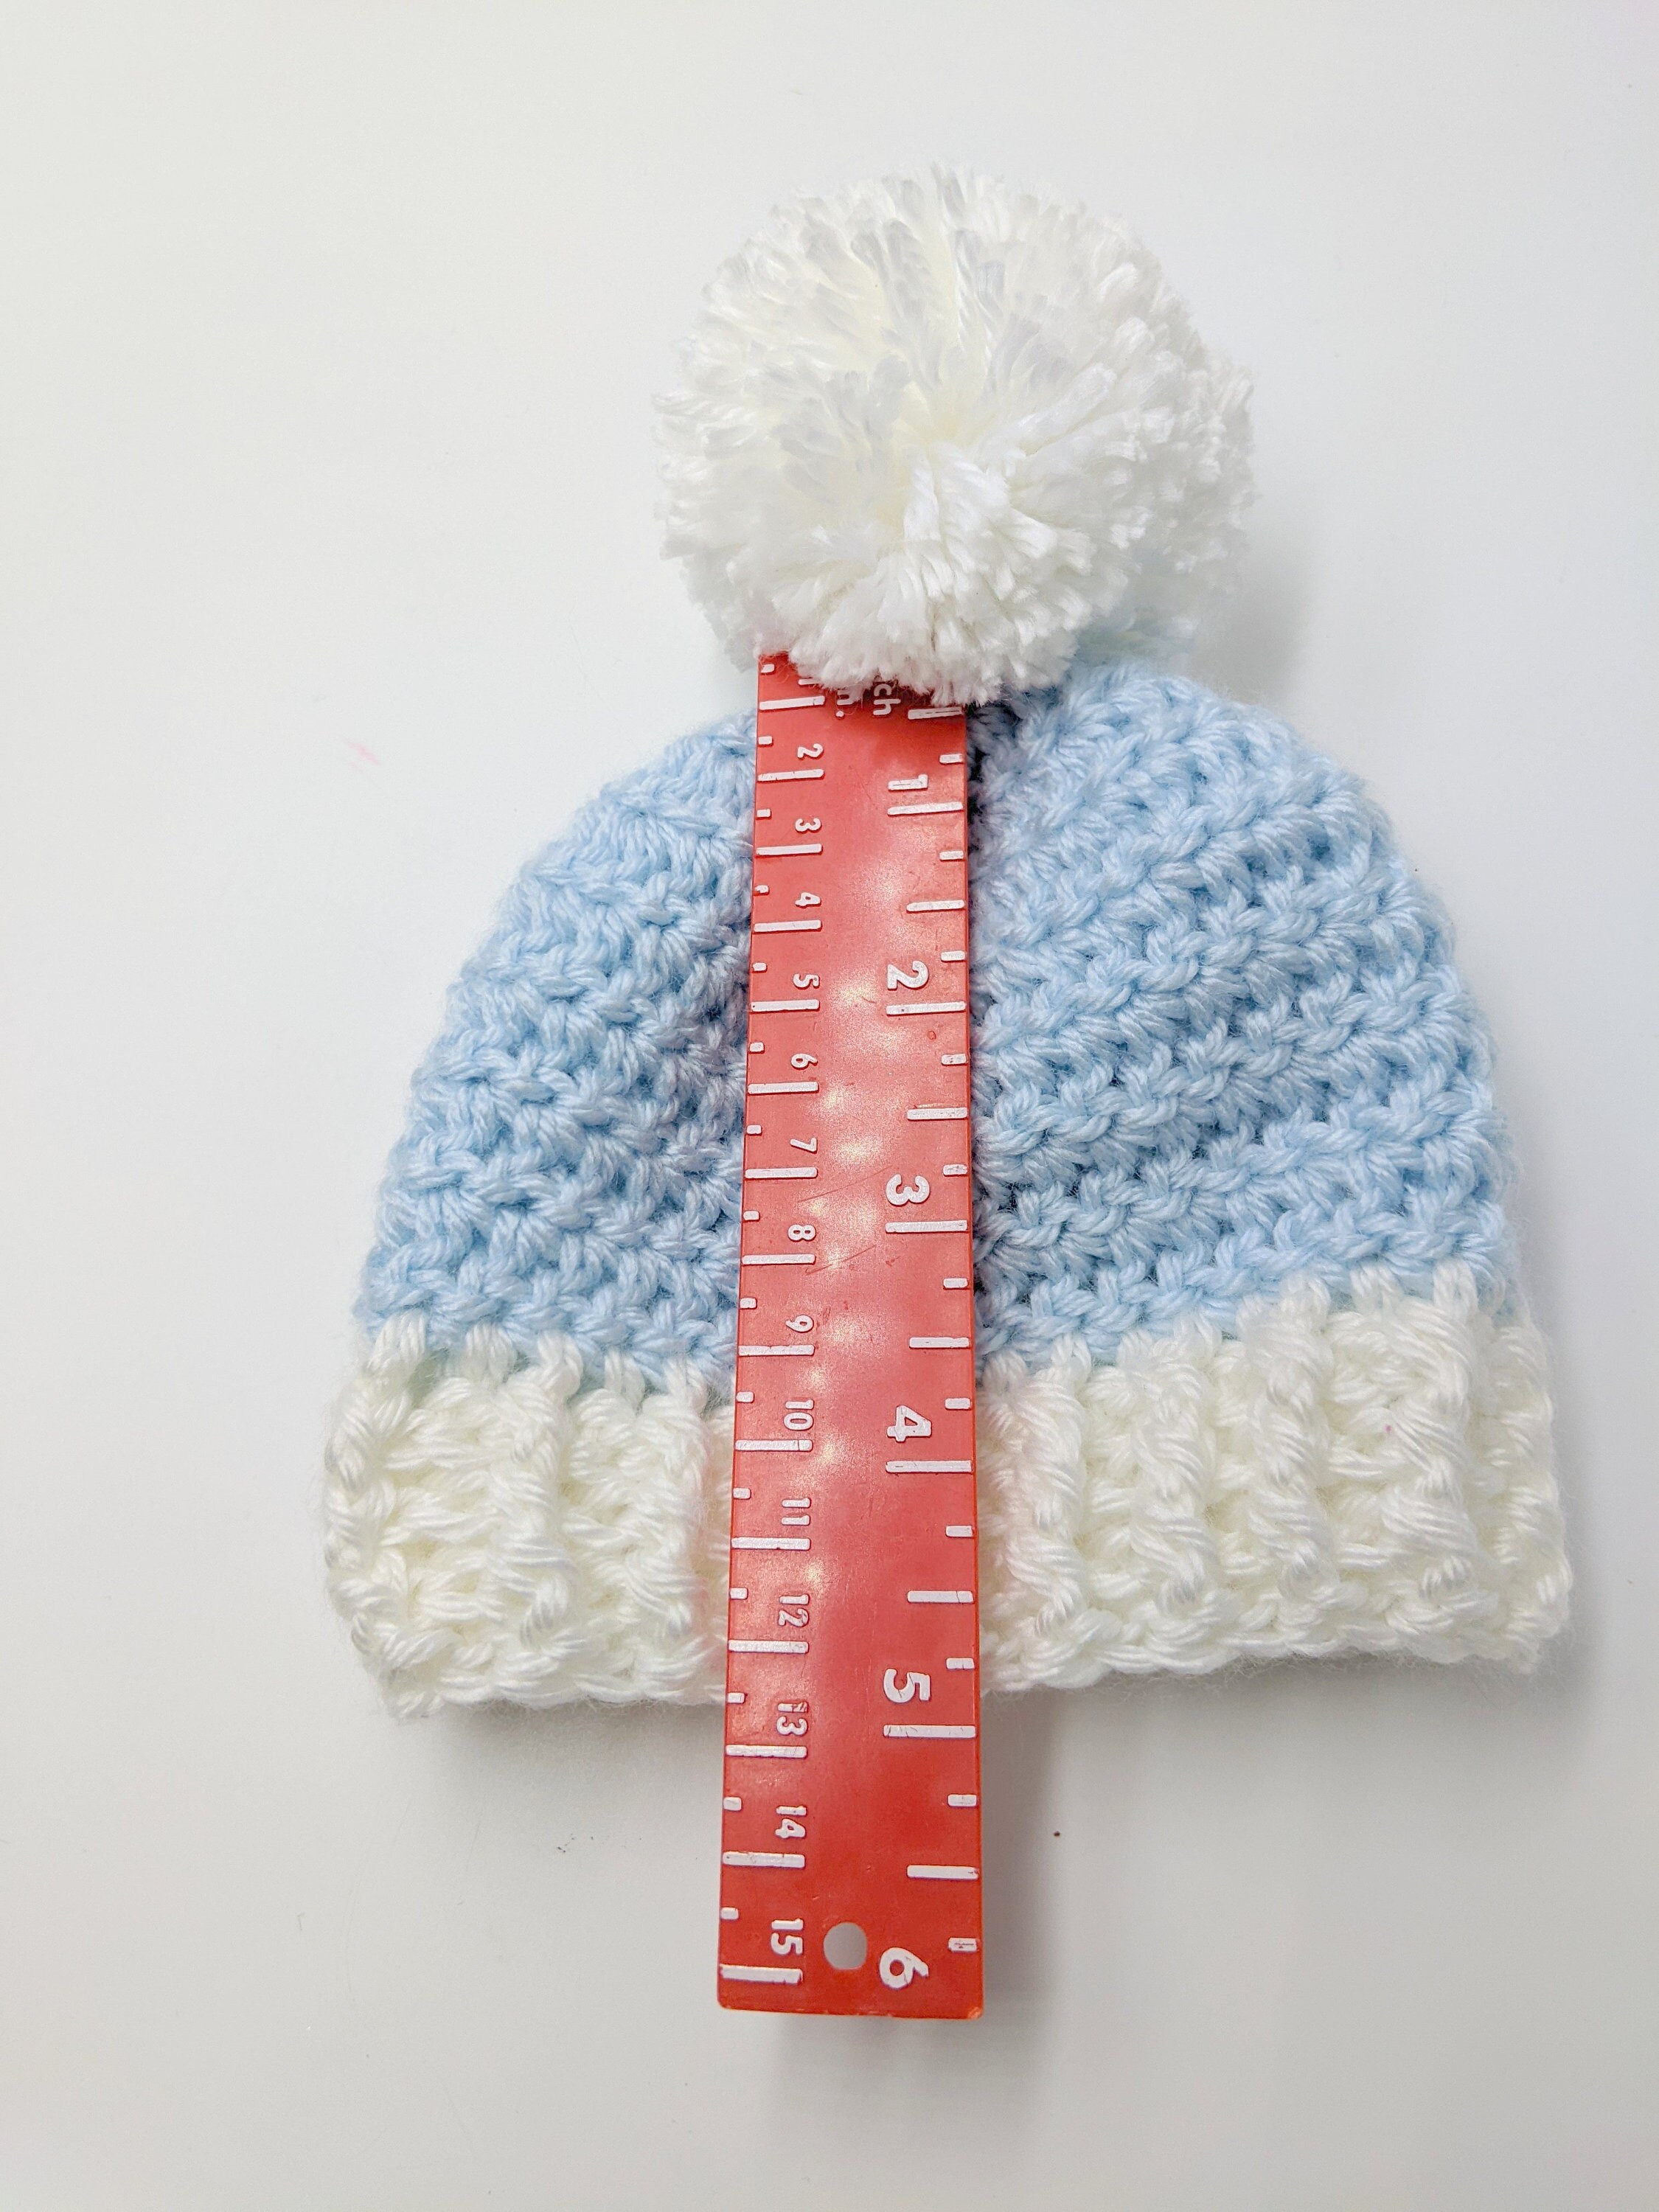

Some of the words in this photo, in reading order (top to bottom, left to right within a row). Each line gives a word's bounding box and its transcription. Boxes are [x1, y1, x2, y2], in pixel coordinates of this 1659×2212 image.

[797, 743, 824, 758] 2
[888, 774, 928, 790] 1
[795, 818, 821, 832] 3
[795, 891, 821, 907] 4
[793, 973, 819, 988] 5
[887, 961, 929, 989] 2
[791, 1053, 818, 1068] 6
[790, 1137, 817, 1152] 7
[886, 1174, 930, 1206] 3
[787, 1224, 816, 1241] 8
[785, 1315, 813, 1332] 9
[784, 1399, 814, 1430] 10
[887, 1405, 932, 1442] 4
[781, 1498, 810, 1526] 11
[778, 1594, 809, 1627] 12
[883, 1668, 931, 1703] 5
[776, 1702, 808, 1736] 13
[775, 1806, 807, 1839] 14
[771, 1919, 803, 1955] 15
[879, 1947, 929, 1989] 6
